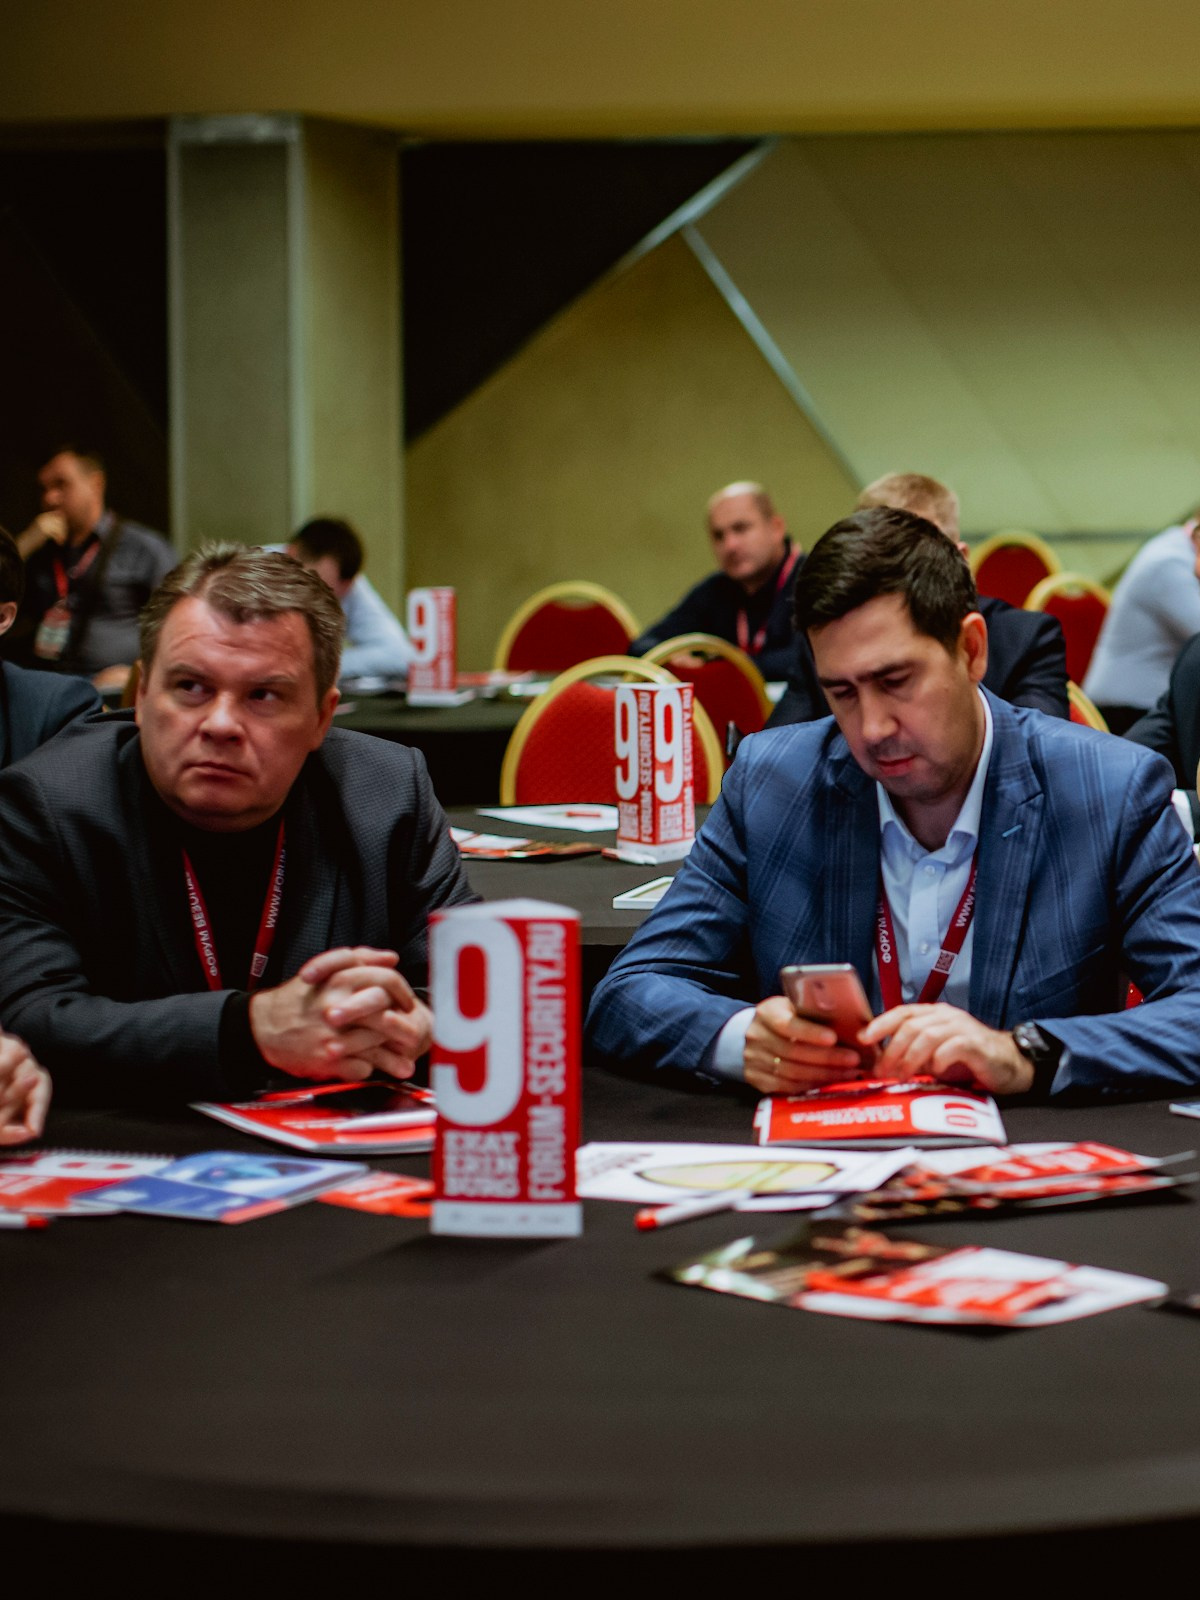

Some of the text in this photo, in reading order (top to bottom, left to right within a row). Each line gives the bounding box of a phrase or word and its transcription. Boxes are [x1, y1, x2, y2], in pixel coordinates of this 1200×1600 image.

[407, 588, 437, 662] 9
[615, 687, 639, 800] 9
[638, 690, 653, 842] FORUM-SECURITY.RU
[654, 689, 683, 803] 9
[199, 930, 218, 977] ФОРУМ
[877, 915, 892, 964] ФОРУМ
[430, 917, 524, 1126] 9
[526, 922, 566, 1200] FORUM-SECURITY.RU
